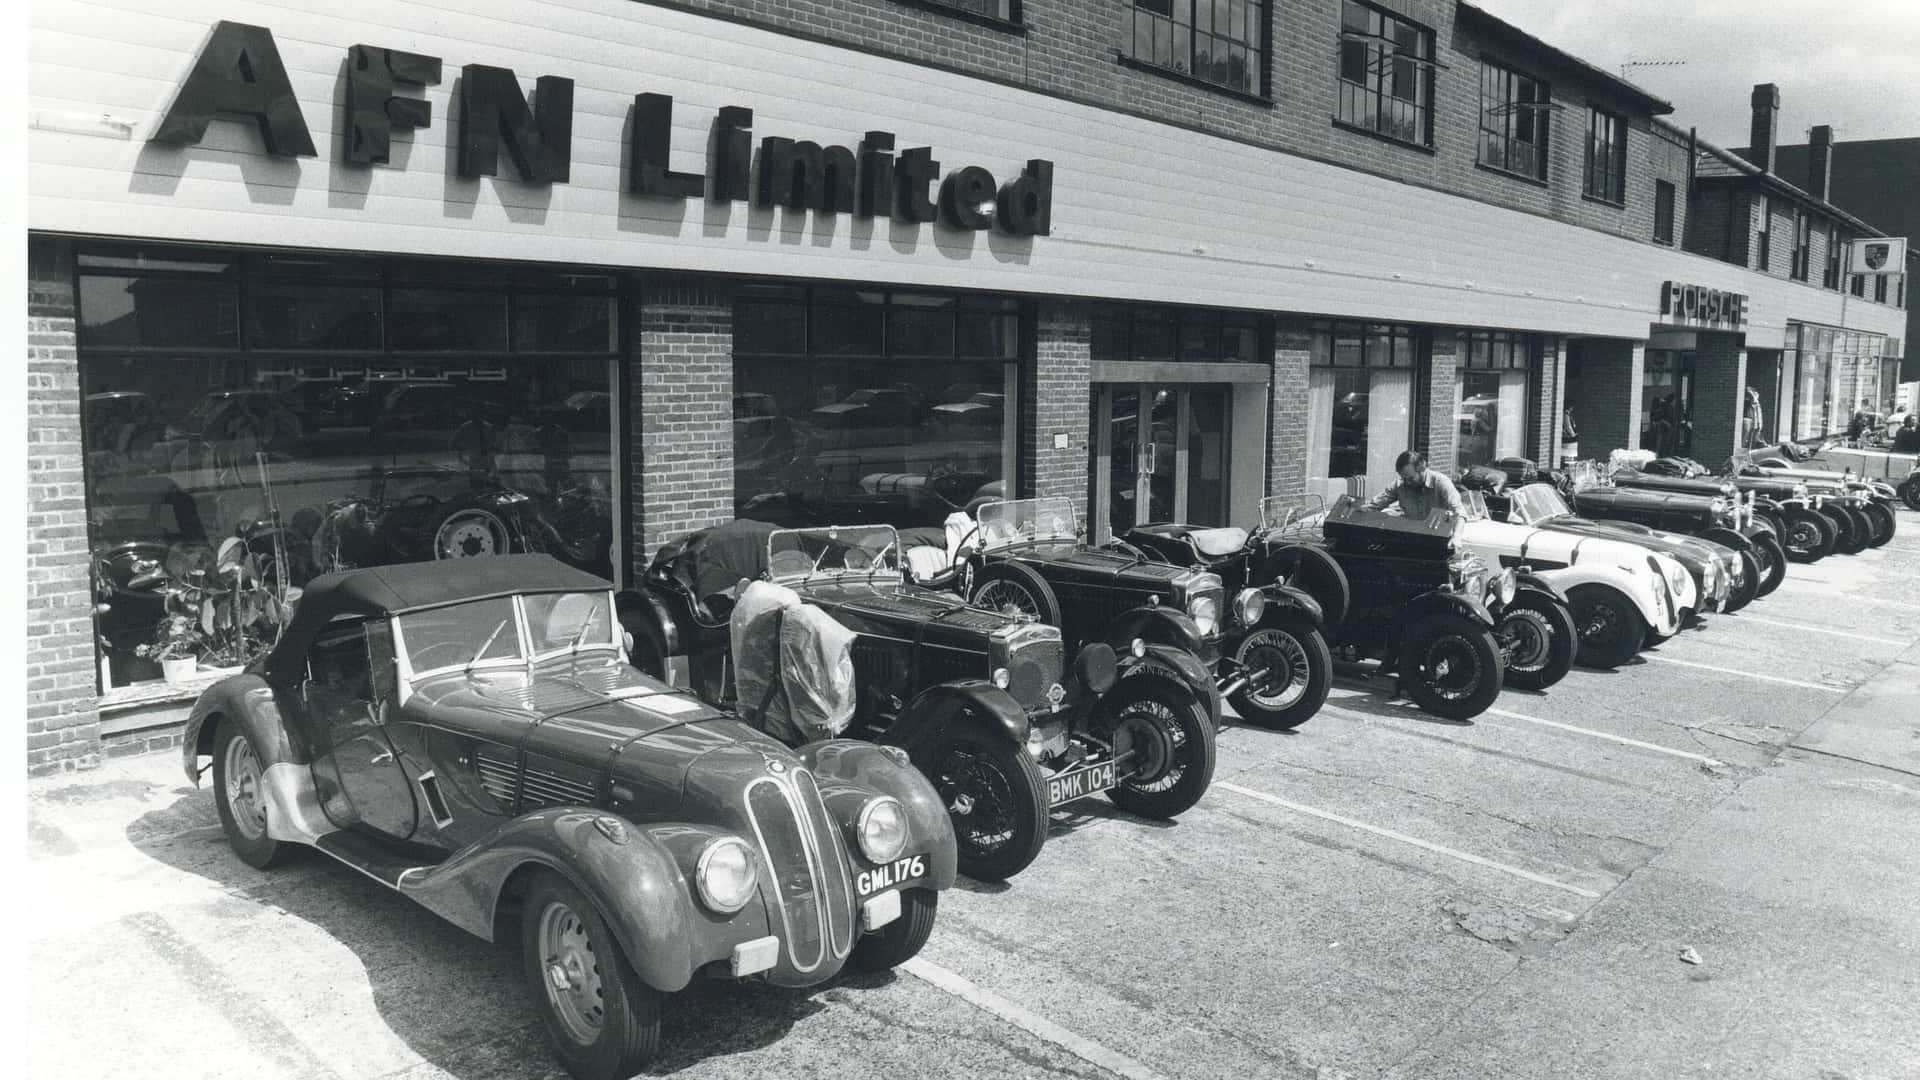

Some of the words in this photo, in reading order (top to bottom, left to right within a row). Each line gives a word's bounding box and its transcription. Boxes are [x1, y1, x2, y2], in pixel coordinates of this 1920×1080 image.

[146, 19, 576, 186] AFN
[630, 91, 1055, 237] Limited
[1661, 281, 1749, 325] PORSCHE
[1050, 773, 1082, 803] BMK
[1087, 765, 1113, 792] 104
